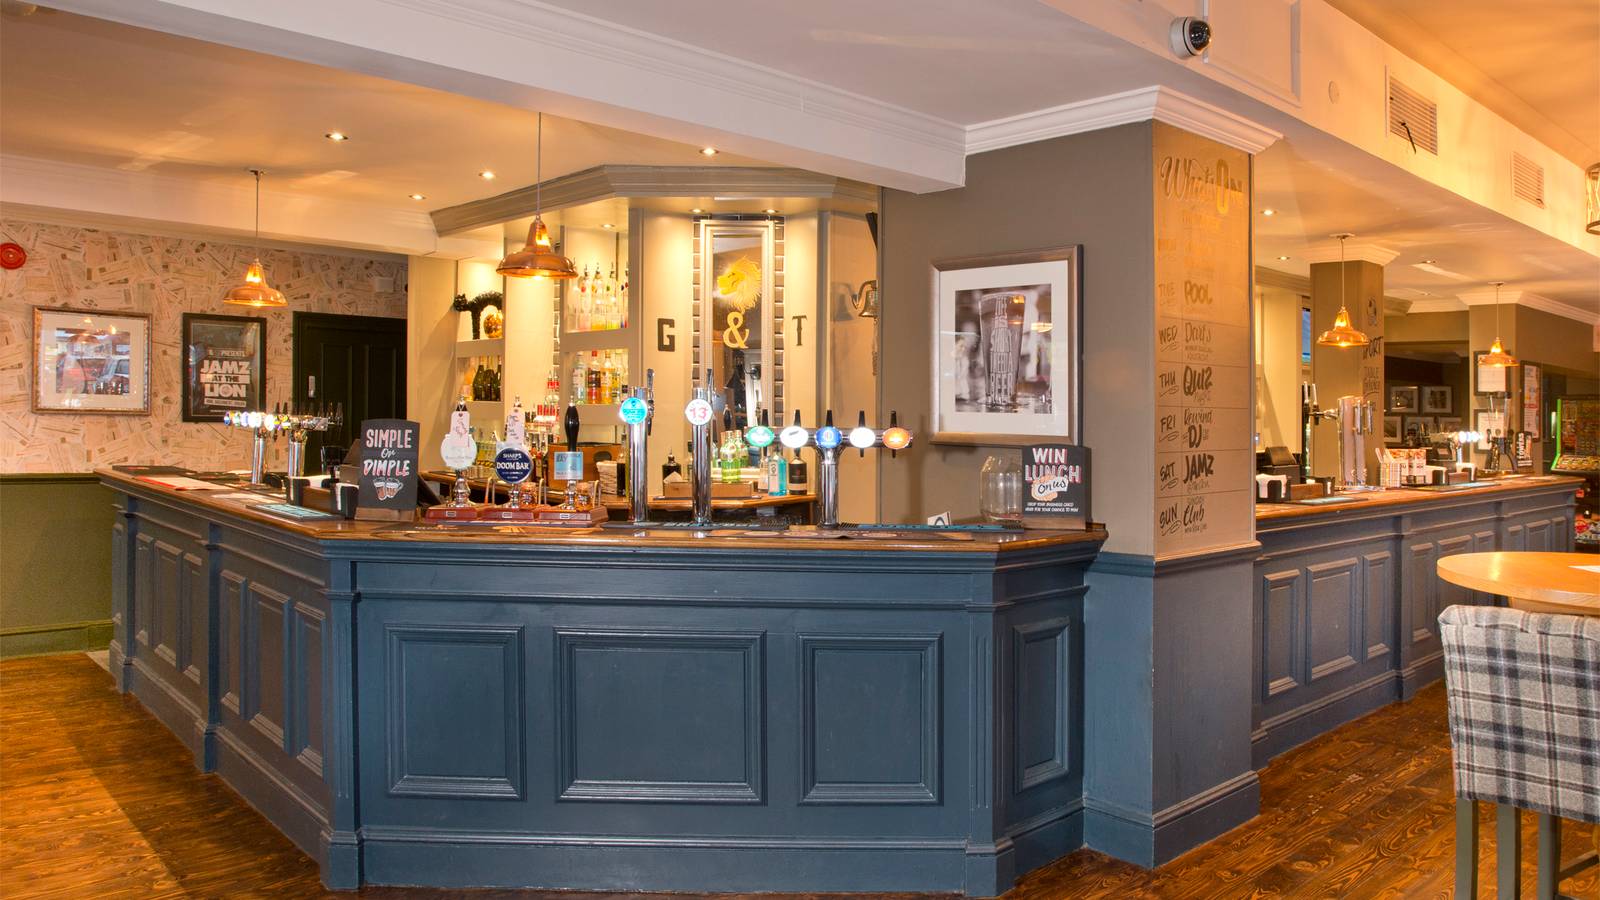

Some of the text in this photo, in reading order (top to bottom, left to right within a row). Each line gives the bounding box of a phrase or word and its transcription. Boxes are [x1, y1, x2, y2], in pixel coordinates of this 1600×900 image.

[1184, 280, 1213, 305] POOL
[657, 311, 808, 352] G & T
[1159, 325, 1178, 344] WED
[201, 360, 250, 375] JAMZ
[1159, 371, 1176, 388] THU
[205, 383, 246, 397] LION
[689, 407, 709, 419] 13
[1160, 414, 1176, 432] FRI
[366, 429, 412, 448] SIMPLE
[1188, 423, 1203, 448] DJ
[1032, 447, 1068, 464] WIN
[363, 459, 411, 477] DIMPLE
[496, 461, 529, 470] DOOM BAR
[1025, 465, 1082, 483] LUNCH
[1160, 462, 1176, 481] SAT
[1183, 453, 1215, 484] JAMZ
[1160, 503, 1178, 529] SUN
[1183, 504, 1205, 526] Club
